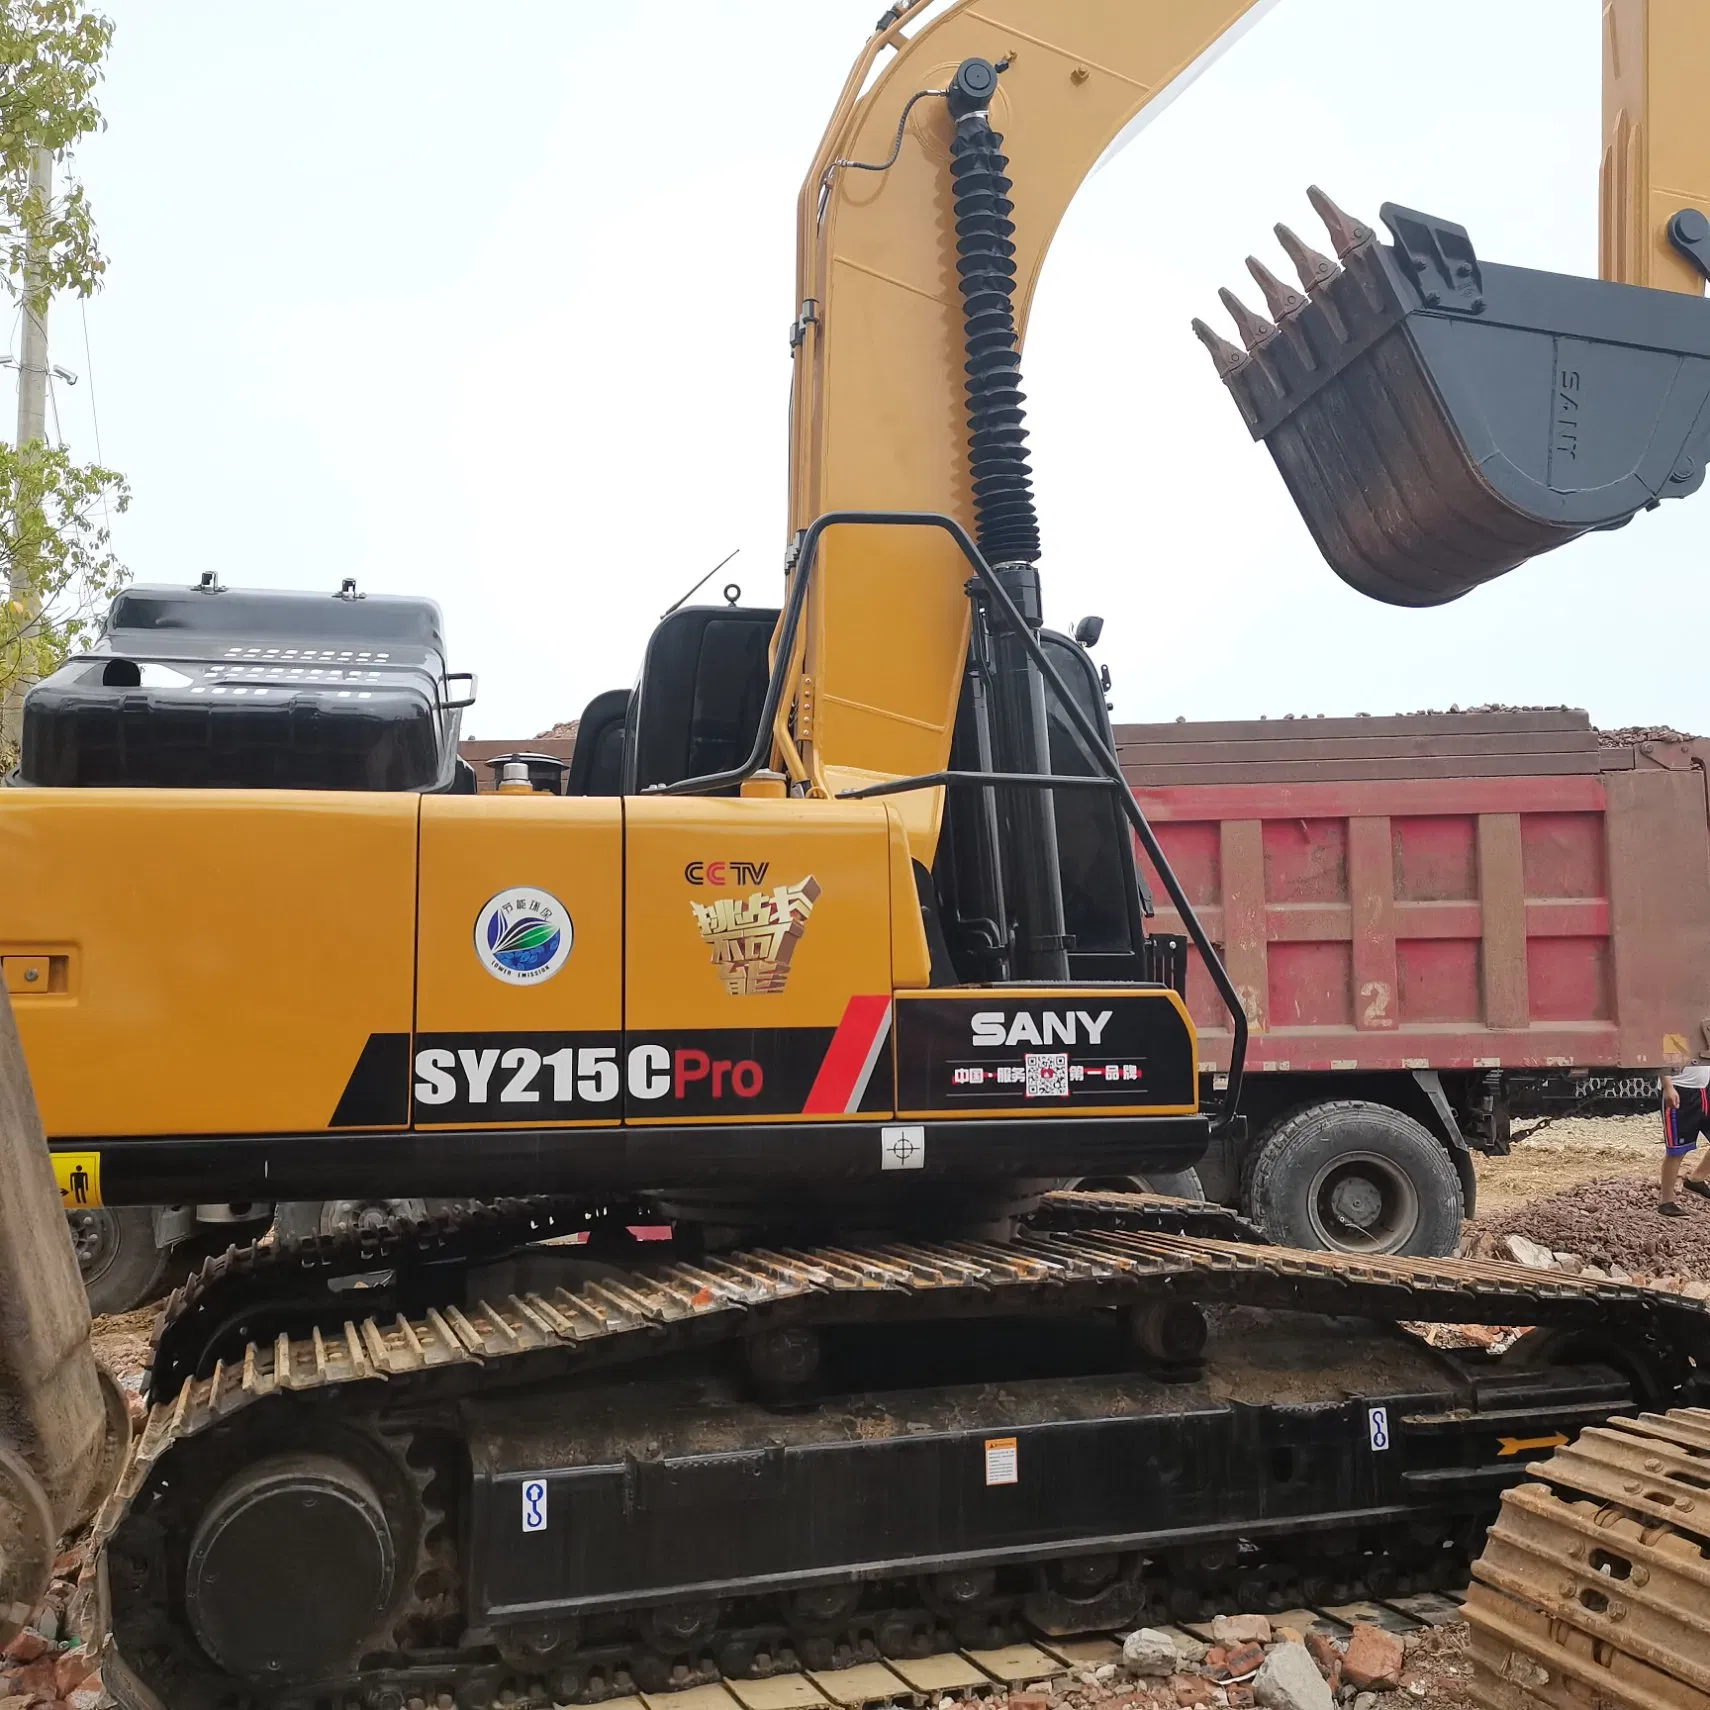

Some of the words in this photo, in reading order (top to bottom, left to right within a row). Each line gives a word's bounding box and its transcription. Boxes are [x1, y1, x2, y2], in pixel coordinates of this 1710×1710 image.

[685, 862, 769, 885] CCTV
[501, 899, 552, 920] 节能环保
[491, 960, 511, 975] LOWER
[517, 965, 549, 978] EMISSION
[1360, 981, 1393, 1028] 2
[970, 1010, 1113, 1047] SANY
